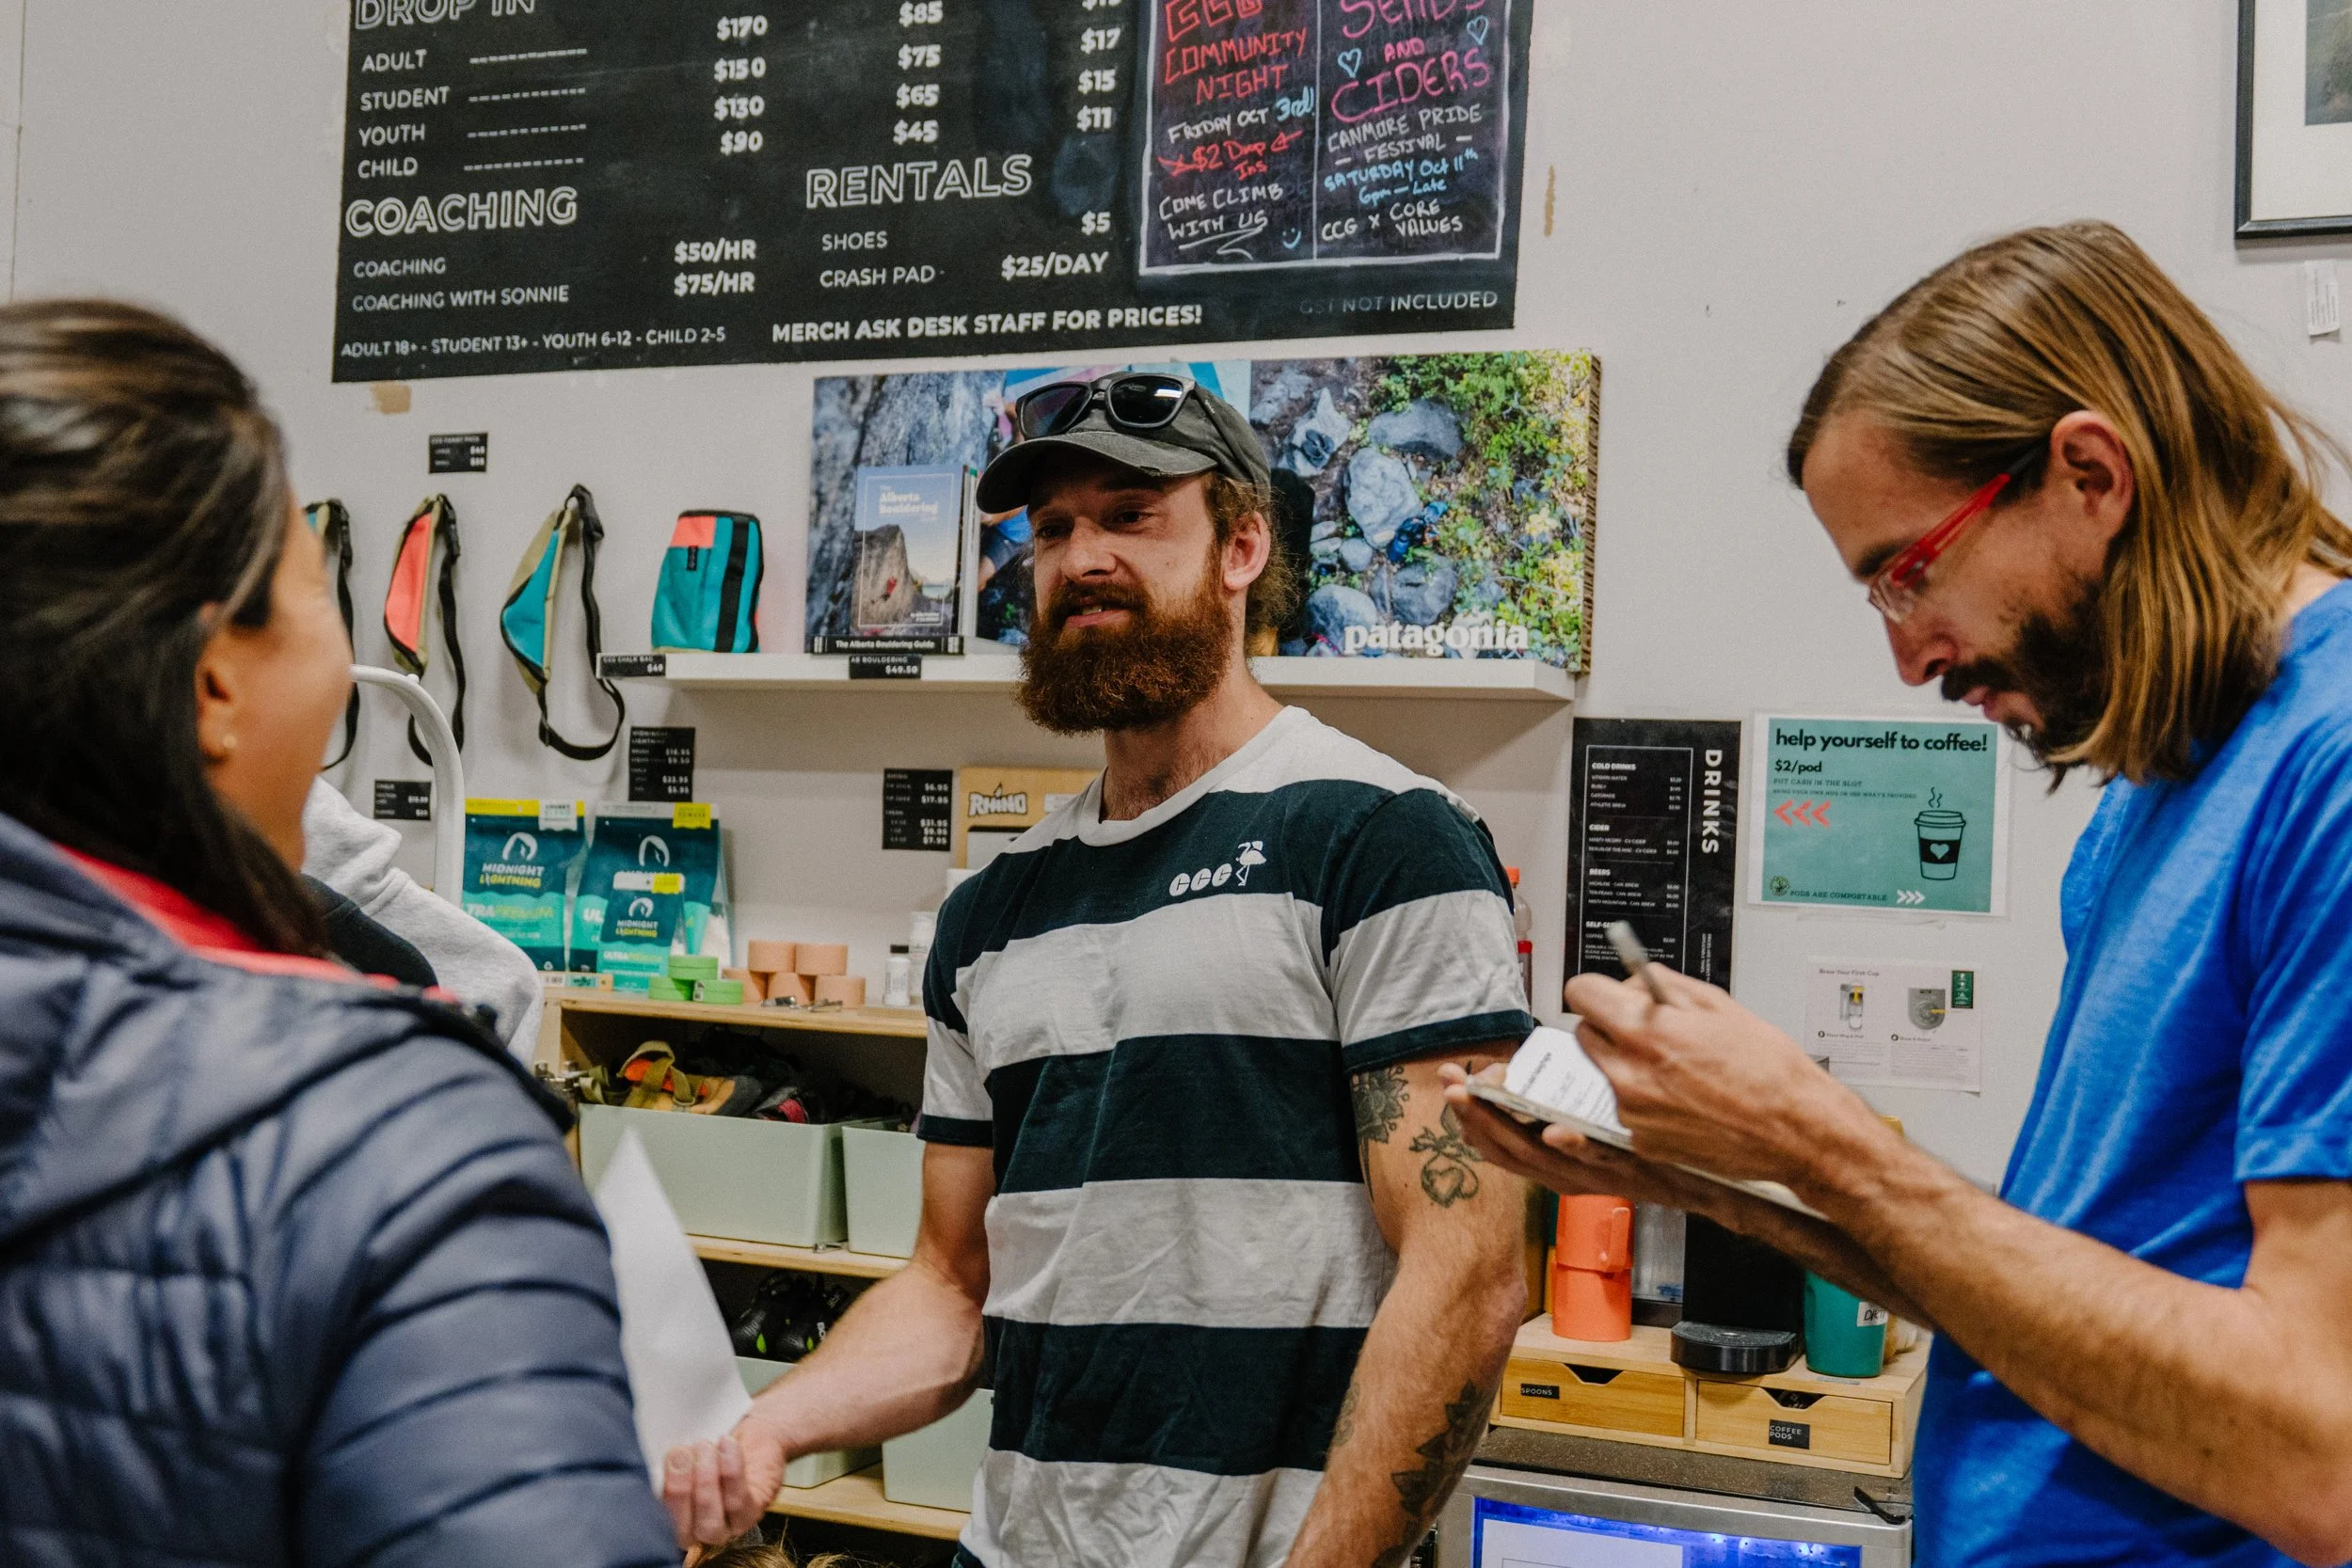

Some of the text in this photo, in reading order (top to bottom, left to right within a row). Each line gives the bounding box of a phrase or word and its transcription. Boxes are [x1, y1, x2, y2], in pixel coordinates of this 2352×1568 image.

[898, 1, 943, 27] $85
[717, 16, 768, 40] $170
[1080, 27, 1121, 55] $17
[1384, 38, 1425, 62] AND
[361, 49, 427, 72] ADULT
[898, 44, 942, 70] $75
[1165, 26, 1307, 85] COMMUNITY
[714, 57, 766, 82] $150
[1078, 68, 1117, 94] $15
[897, 83, 940, 108] $65
[1196, 63, 1289, 105] NIGHT
[1331, 47, 1490, 122] CIDERS
[359, 86, 451, 112] STUDENT
[714, 95, 765, 120] $130
[1076, 105, 1113, 132] $11
[1168, 114, 1232, 143] FRIDAY
[1237, 107, 1269, 126] OCT
[1327, 103, 1482, 152] CANMORE PRIDE
[359, 123, 425, 148] YOUTH
[720, 130, 763, 156] $90
[893, 119, 939, 145] $45
[1192, 143, 1223, 172] $2
[1365, 134, 1446, 163] FESTIVAL
[358, 157, 419, 178] CHILD
[1324, 159, 1414, 192] SATURDAY
[1420, 157, 1449, 176] Oct
[806, 153, 1033, 209] RENTALS
[345, 186, 578, 237] COACHING
[1159, 182, 1283, 220] COME CLIMB
[1081, 211, 1111, 235] $5
[1168, 210, 1268, 240] WITH US
[1321, 217, 1358, 241] CCG
[1390, 198, 1440, 220] CORE
[1395, 215, 1463, 236] VALUES
[675, 239, 756, 264] $50/HR
[821, 231, 888, 252] SHOES
[354, 257, 446, 277] COACHING
[819, 265, 935, 289] CRASH PAD
[1001, 251, 1109, 281] $25/DAY
[674, 272, 755, 297] $75/HR
[352, 285, 569, 312] COACHING WITH SONNIE
[1343, 295, 1384, 312] NOT
[1391, 290, 1498, 312] INCLUDED
[772, 305, 1201, 343] MERCH ASK DESK STAFF FOR PRICES!
[341, 325, 726, 357] ADULT 18+ STUDENT 13+ YOUTH 6-12 CHILD 2-5
[835, 640, 935, 650] The Alberta Bouldering Guide
[1343, 620, 1529, 657] patagonia
[1775, 728, 1988, 752] help yourself to coffee!
[1592, 762, 1611, 770] COLD
[1774, 758, 1822, 775] $2/pod
[968, 792, 1027, 817] RHINO
[1702, 749, 1723, 854] DRINKS
[480, 875, 542, 888] LIGHTNING
[483, 863, 544, 877] MIDNIGHT
[1829, 892, 1887, 901] COMPOSTABLE
[615, 927, 658, 938] LIGHTNING
[617, 919, 659, 928] MIDNIGHT
[1520, 1387, 1552, 1396] SPOONS
[1770, 1425, 1802, 1435] COFFEE
[1770, 1432, 1792, 1440] PODS
